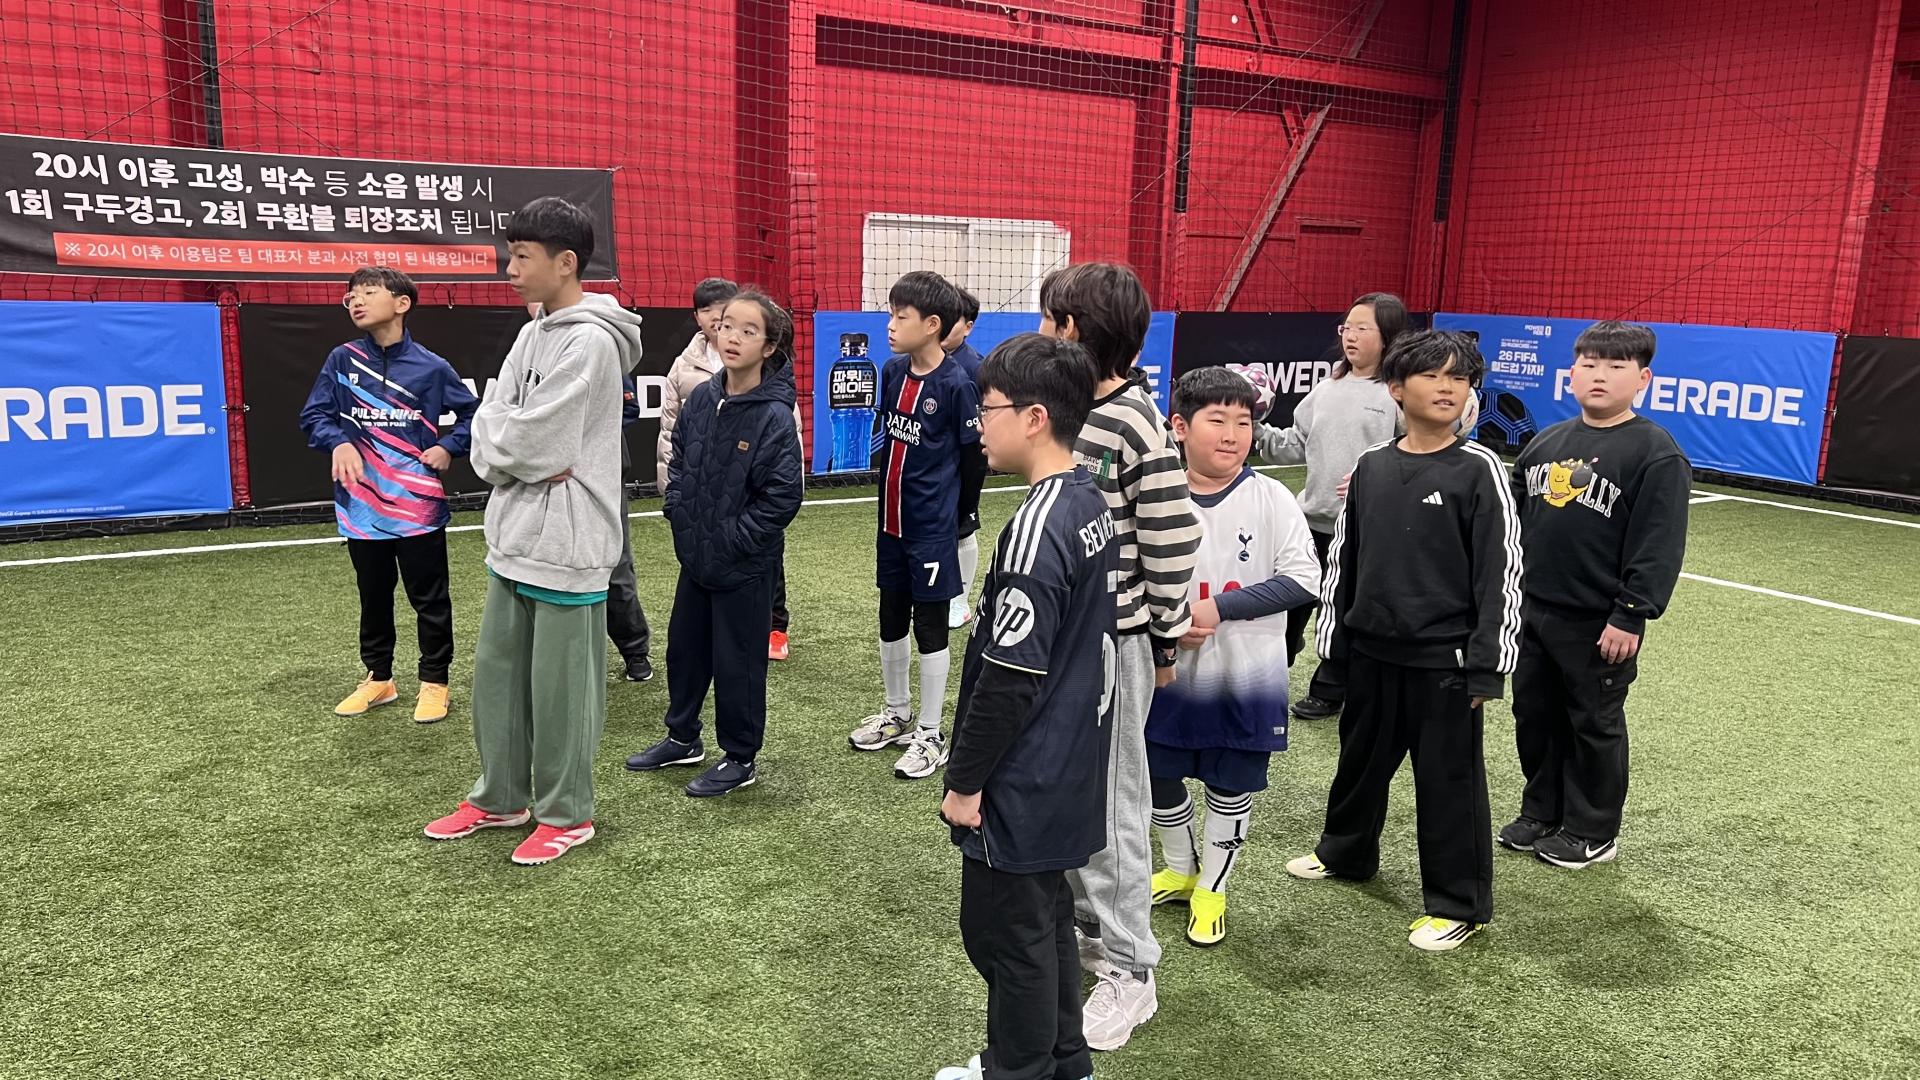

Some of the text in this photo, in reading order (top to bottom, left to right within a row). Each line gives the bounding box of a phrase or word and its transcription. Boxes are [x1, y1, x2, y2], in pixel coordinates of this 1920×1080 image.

[32, 152, 493, 202] 20시 이후 고성, 박수 등 소음 발생 시
[4, 188, 53, 220] 1회
[62, 191, 193, 227] 구두경고,
[200, 200, 247, 229] 2회
[256, 202, 336, 232] 무환불
[344, 205, 444, 234] 퇴장조치
[87, 243, 126, 259] 20시
[131, 244, 165, 261] 이후
[169, 246, 233, 264] 이용팀은
[237, 248, 252, 265] 팀
[258, 248, 301, 265] 대표자
[341, 250, 369, 265] 사전
[373, 250, 401, 267] 협의
[405, 251, 418, 266] 된
[422, 251, 488, 266] 내용입니다
[1498, 350, 1537, 363] 26 FIFA
[832, 370, 862, 382] 파워
[832, 382, 874, 393] 에이드
[351, 406, 422, 421] PULSE NINE
[888, 426, 921, 446] AIRWAYS
[923, 562, 940, 587] 7
